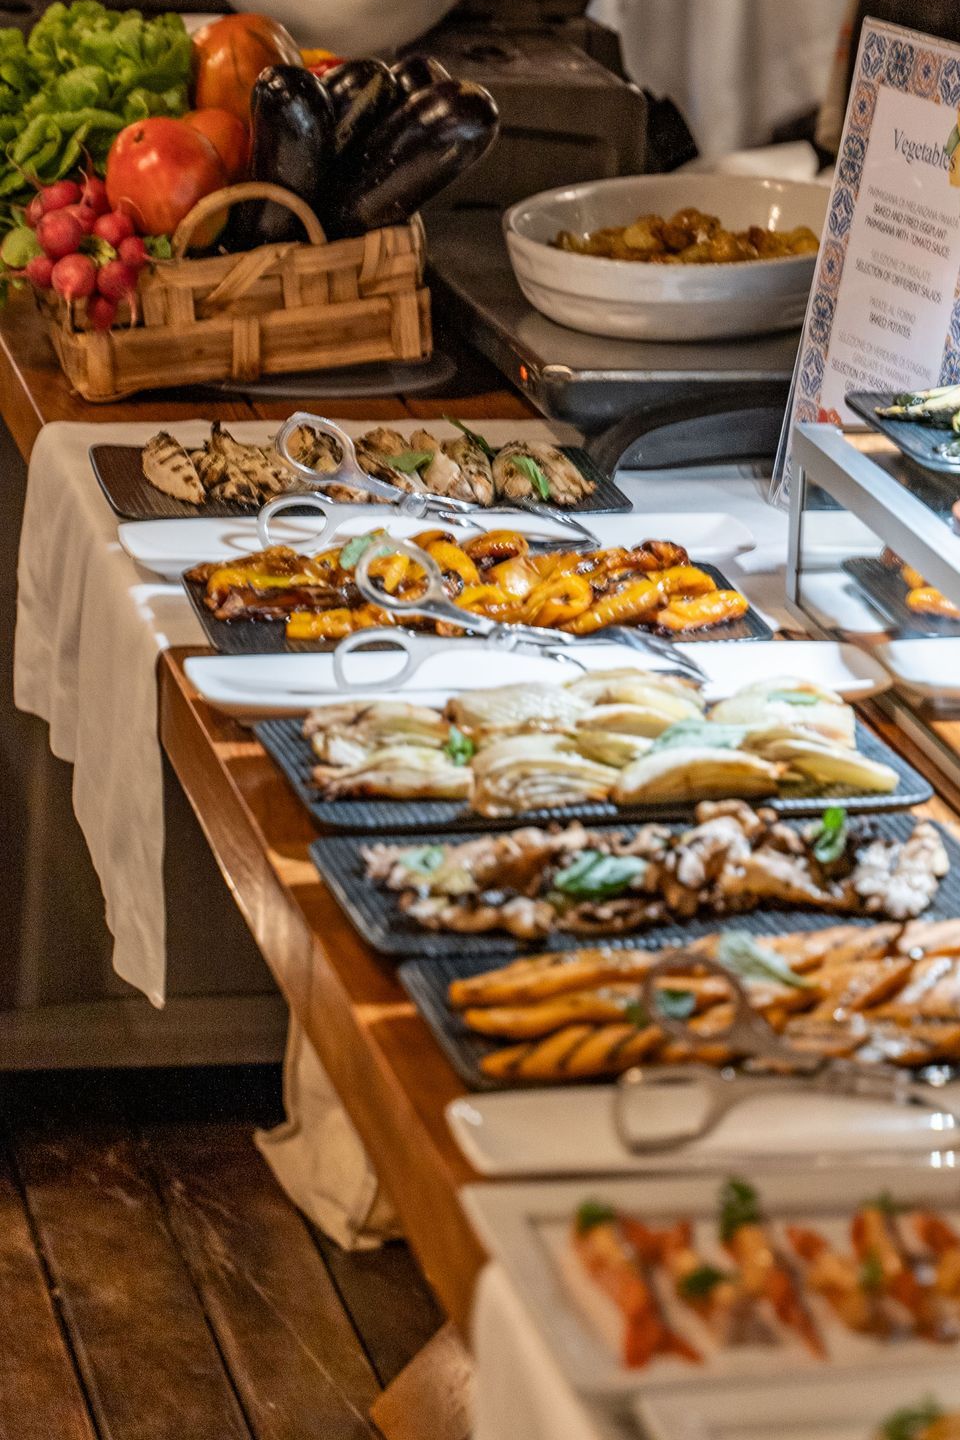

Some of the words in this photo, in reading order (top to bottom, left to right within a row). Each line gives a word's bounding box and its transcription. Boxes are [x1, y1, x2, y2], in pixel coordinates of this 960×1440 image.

[893, 127, 957, 174] Vegetables
[874, 203, 891, 218] BAKED
[891, 210, 903, 223] AND
[904, 215, 919, 229] FRIED
[911, 234, 931, 250] TOMATO
[932, 242, 951, 258] SAUCE
[856, 258, 883, 279] SELECTION
[892, 273, 921, 294] DIFFERENT
[921, 284, 943, 304] SALADS
[869, 312, 887, 328] BAKED
